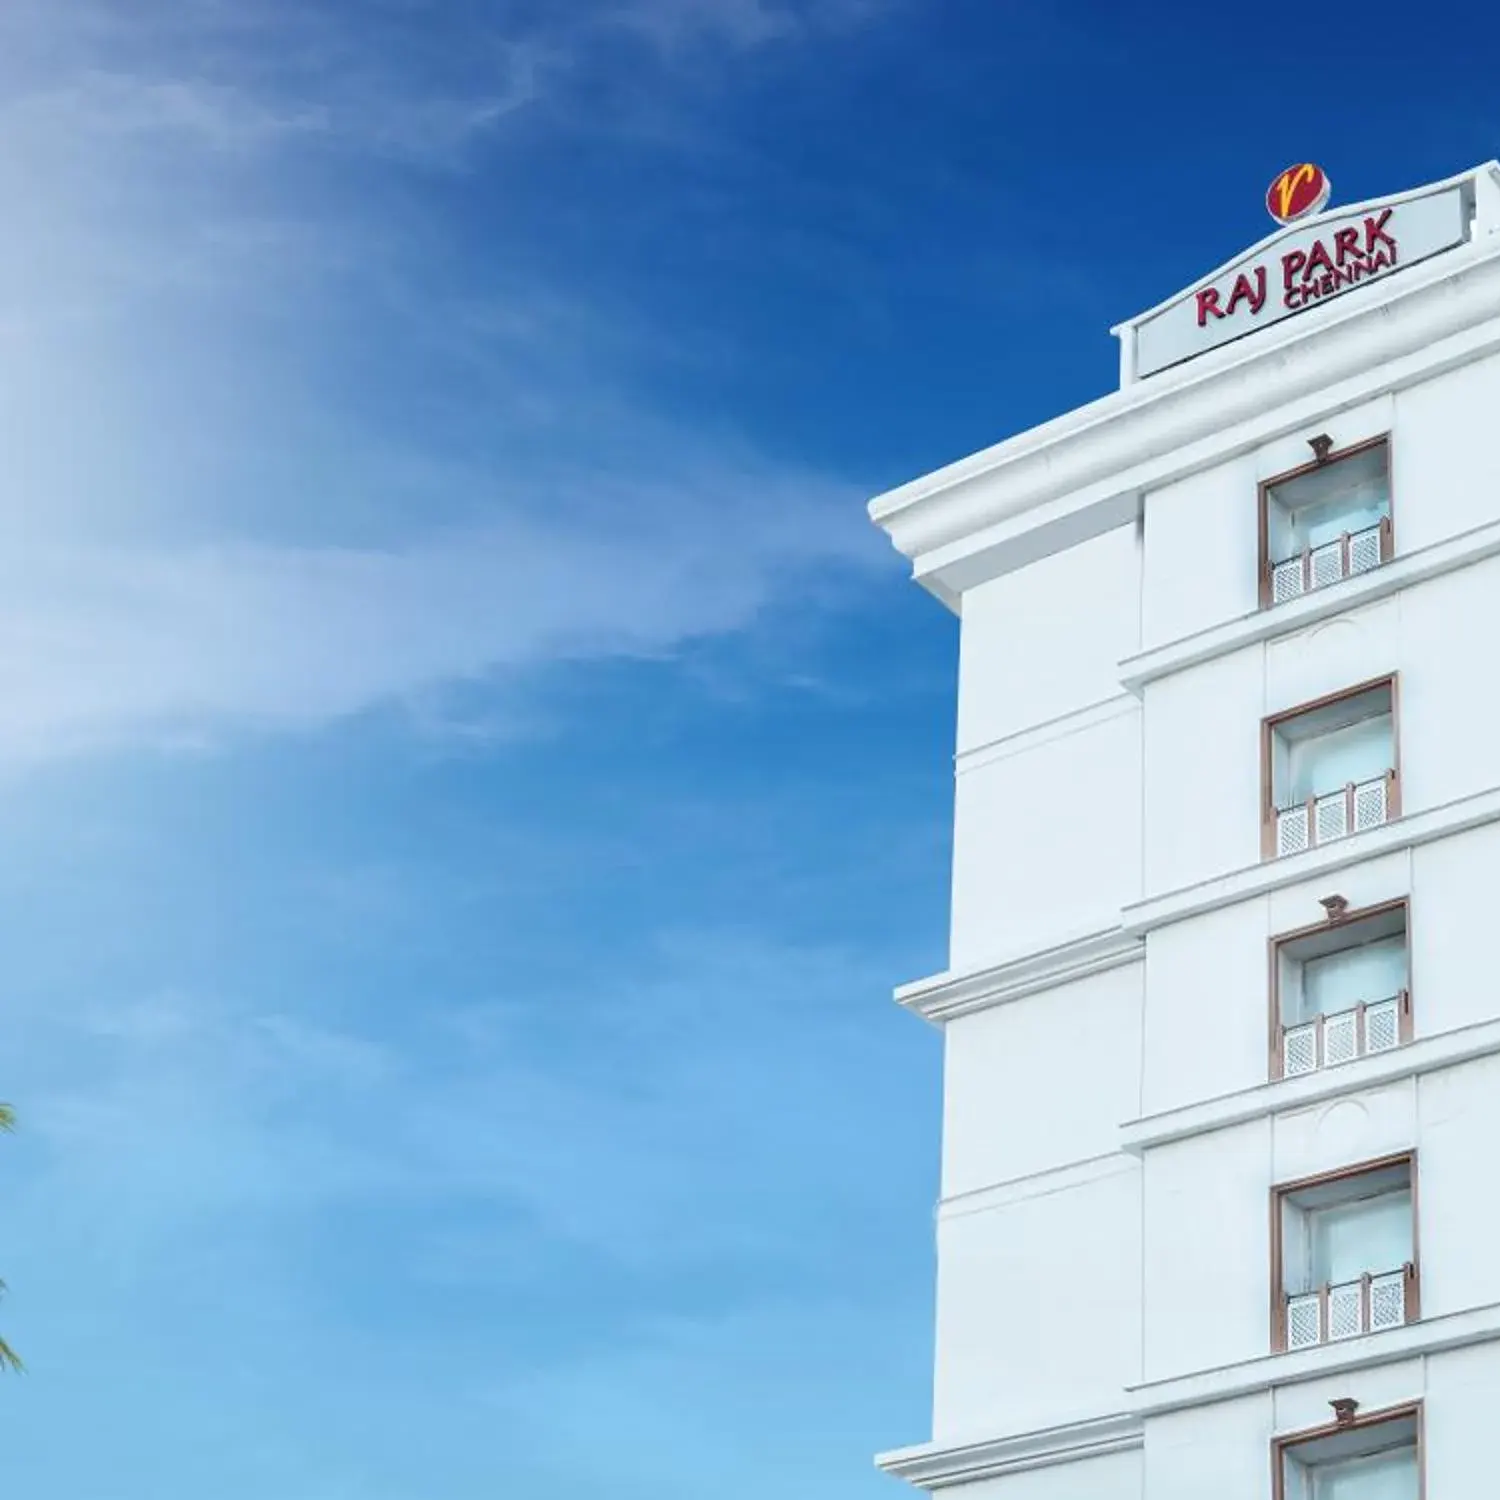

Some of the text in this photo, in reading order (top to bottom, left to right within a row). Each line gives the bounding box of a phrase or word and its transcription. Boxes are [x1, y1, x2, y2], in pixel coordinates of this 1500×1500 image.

[1196, 207, 1396, 327] RAJ PARK
[1283, 242, 1398, 309] CHENNAI
